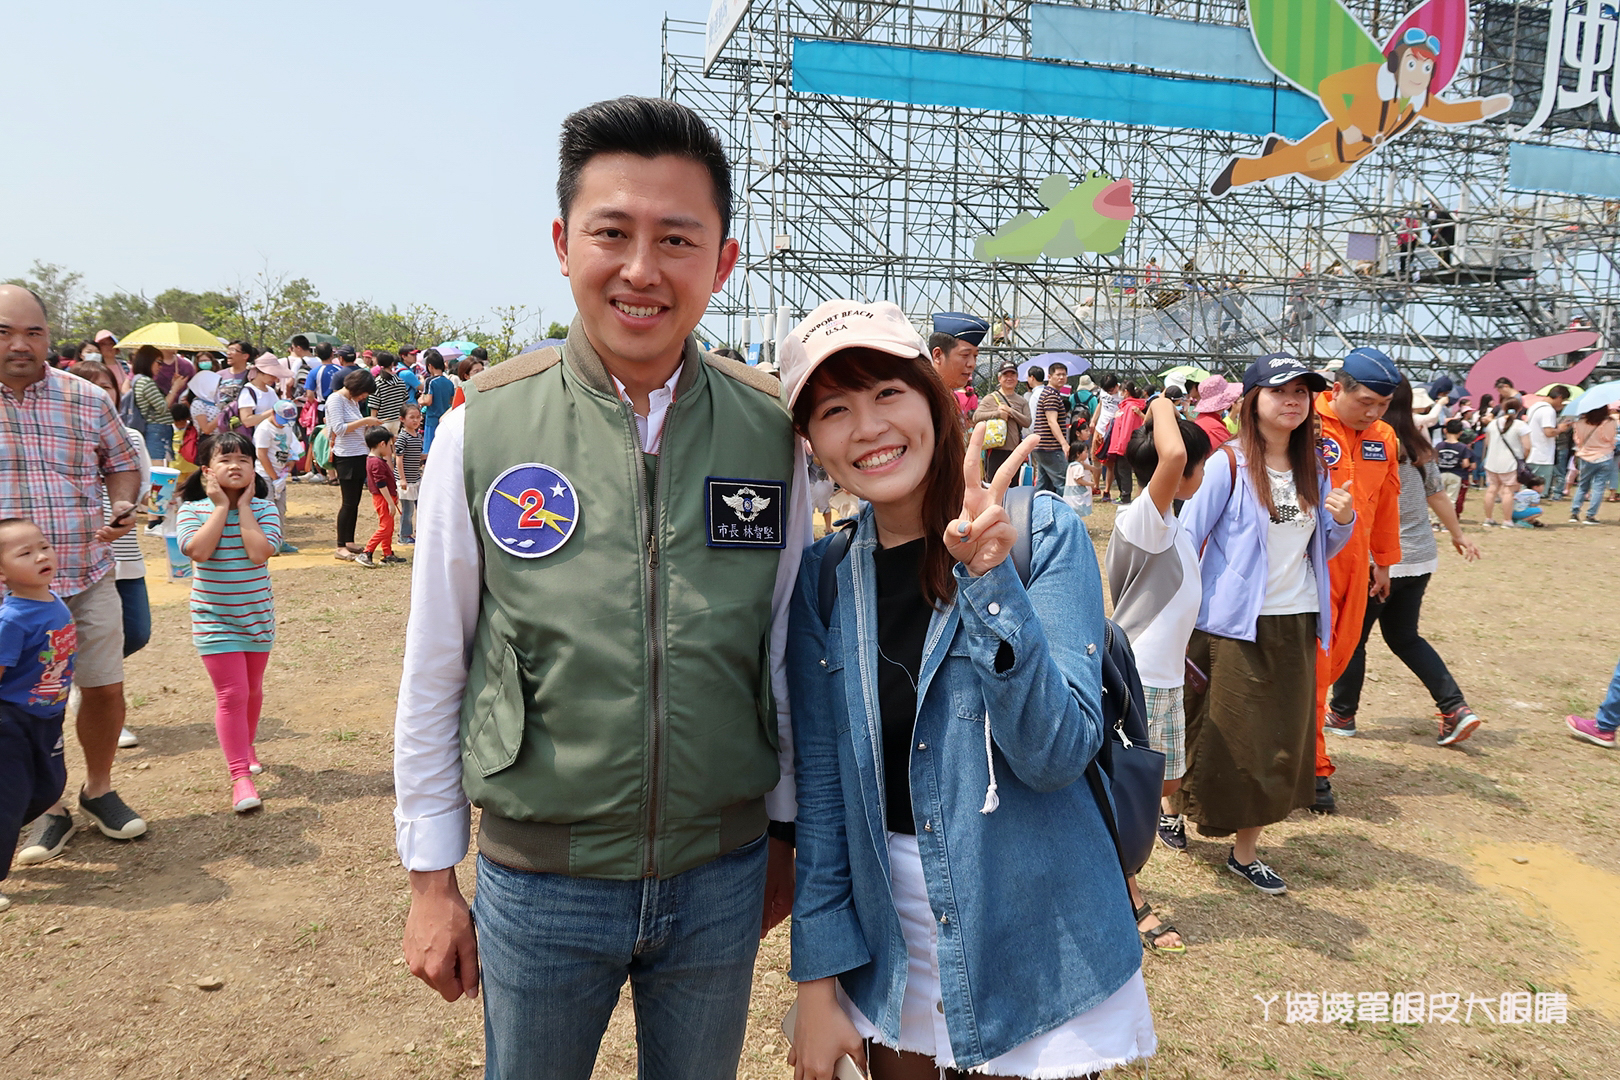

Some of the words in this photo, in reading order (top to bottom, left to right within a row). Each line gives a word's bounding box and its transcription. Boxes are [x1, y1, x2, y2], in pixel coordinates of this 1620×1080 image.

[801, 313, 839, 344] NEWPORT
[841, 309, 874, 319] BEACH
[517, 488, 545, 530] 2
[717, 522, 740, 538] 市長
[743, 524, 775, 540] 林智堅
